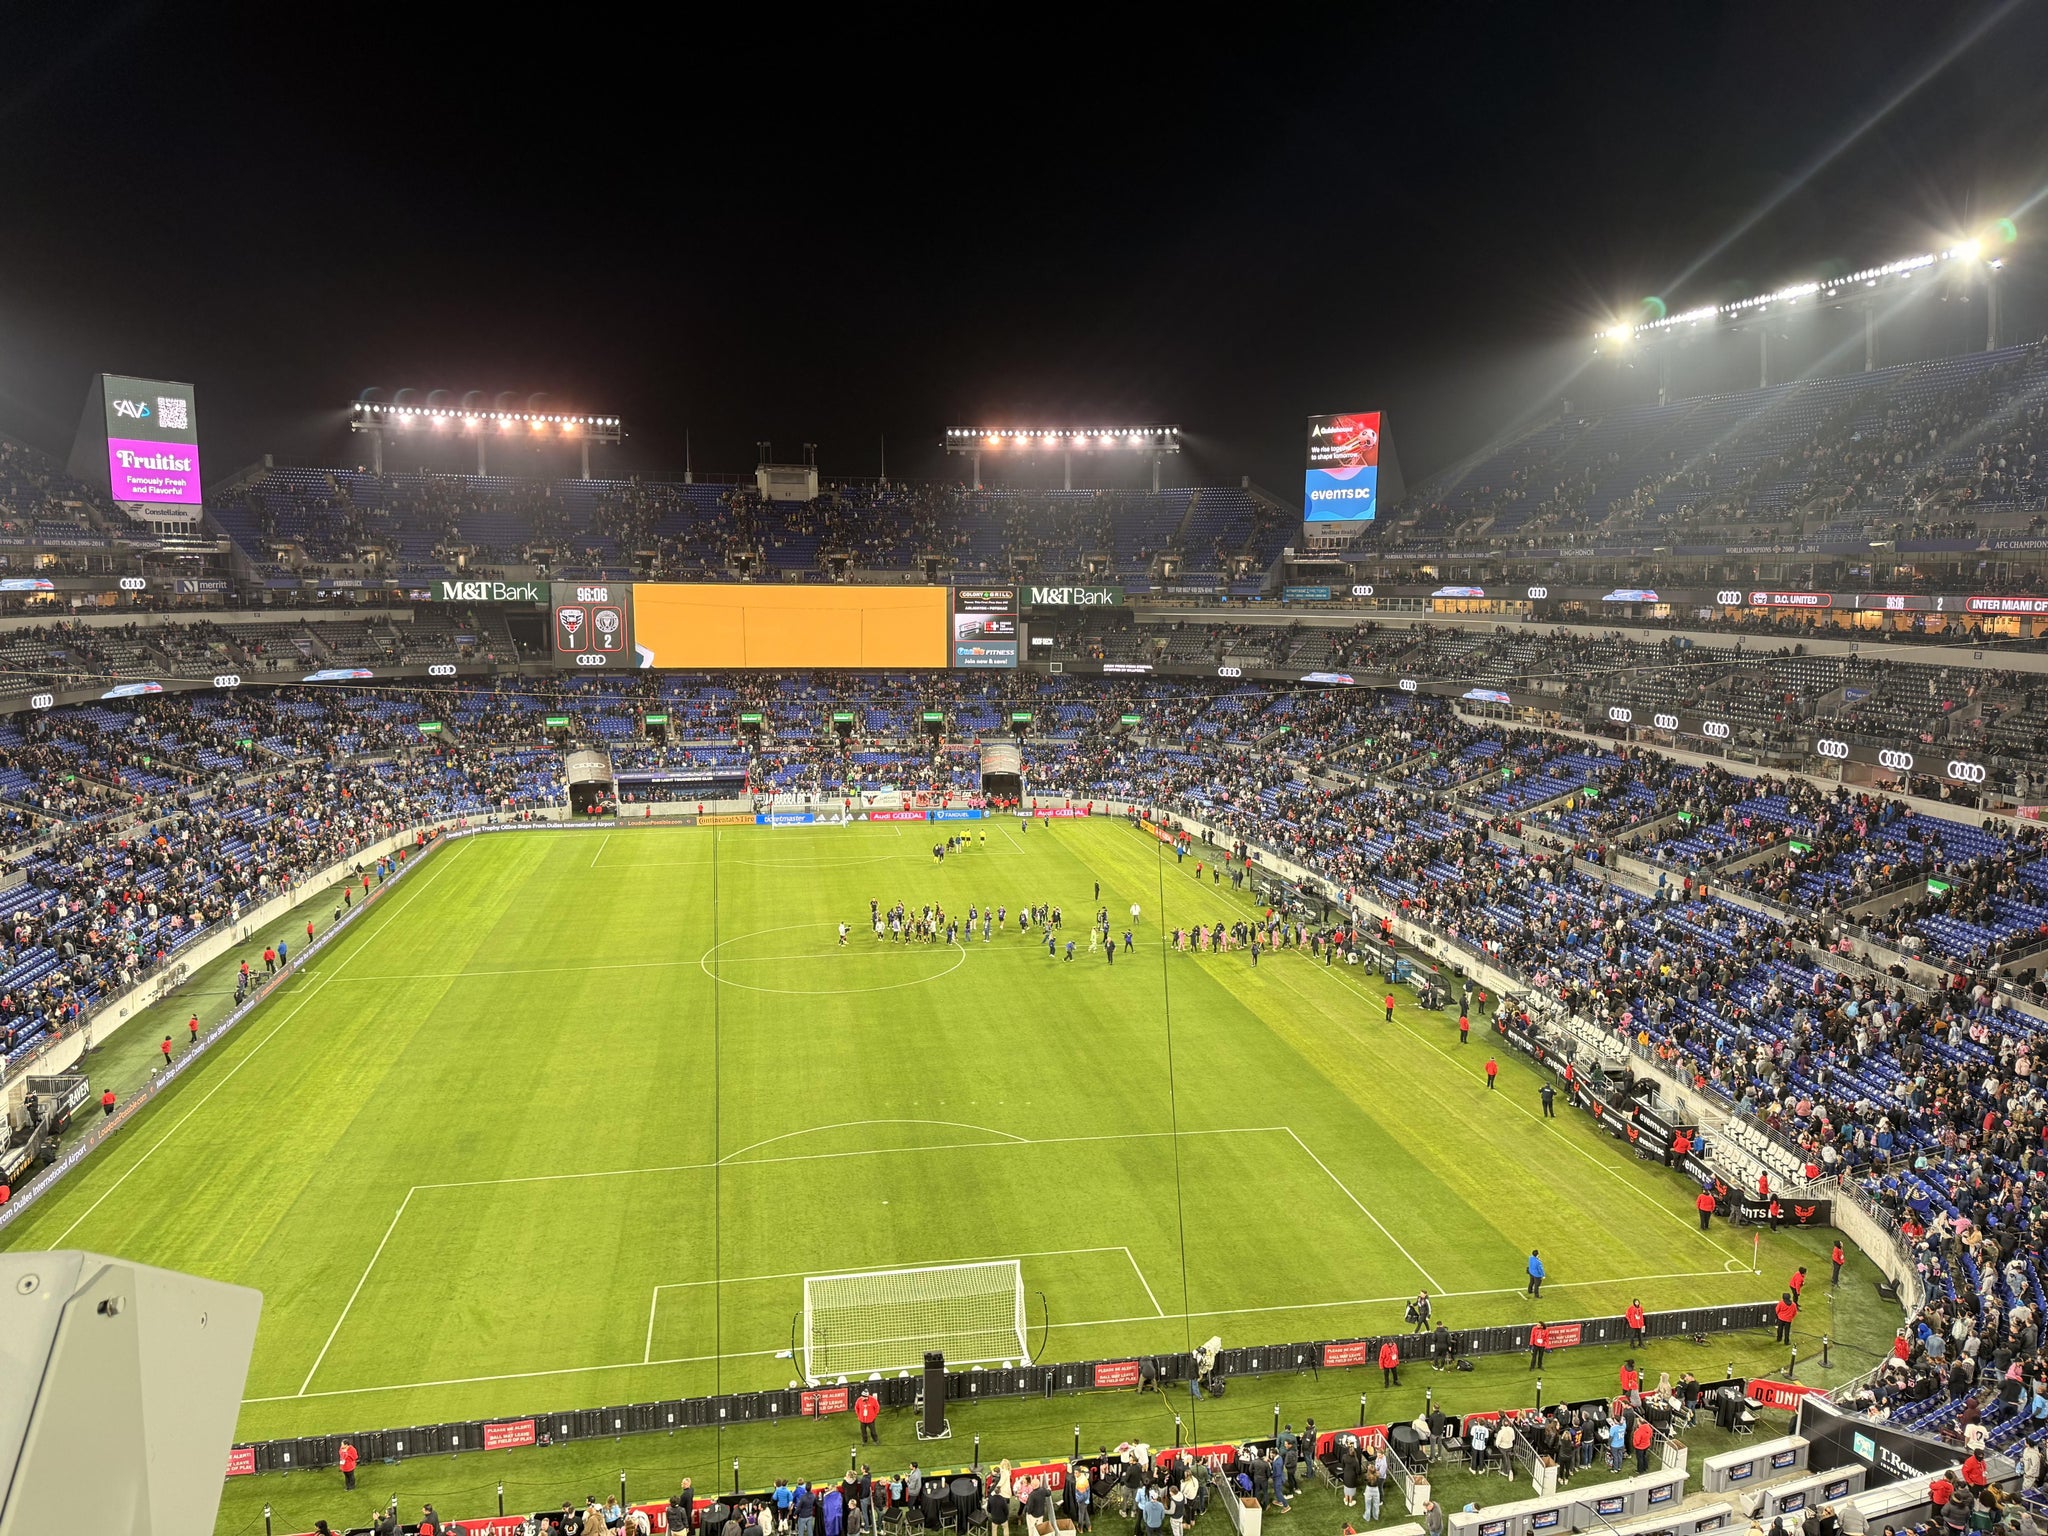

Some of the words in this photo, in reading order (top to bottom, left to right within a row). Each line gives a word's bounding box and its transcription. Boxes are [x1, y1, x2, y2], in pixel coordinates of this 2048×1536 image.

[116, 450, 192, 472] Fruitist
[127, 476, 164, 486] Famously
[165, 478, 187, 486] Fresh
[148, 486, 182, 495] Flavorful
[1355, 488, 1370, 498] DC
[144, 508, 188, 516] Constellation
[442, 582, 492, 600] M&T
[493, 583, 538, 600] Bank
[577, 588, 608, 601] 96:06
[1031, 587, 1072, 604] M&T
[1074, 588, 1112, 605] Bank
[1790, 596, 1818, 605] UNITED
[1855, 596, 1859, 608] 1
[1937, 598, 1942, 611] 2
[1972, 600, 2000, 610] INTER
[2002, 600, 2032, 611] MIAMI
[2034, 601, 2048, 611] CF
[569, 634, 575, 648] 1
[604, 634, 612, 648] 2
[175, 1052, 192, 1072] Loudoun
[192, 1042, 205, 1058] County
[98, 1092, 148, 1139] LoudounPossible.com
[1661, 1128, 1668, 1138] DC
[1657, 1146, 1664, 1156] DC
[13, 1192, 32, 1213] Dulles
[32, 1162, 68, 1197] International
[68, 1144, 87, 1166] Airport
[1756, 1387, 1774, 1402] D.C.
[1775, 1390, 1798, 1406] UNI
[470, 1526, 518, 1536] UNITE
